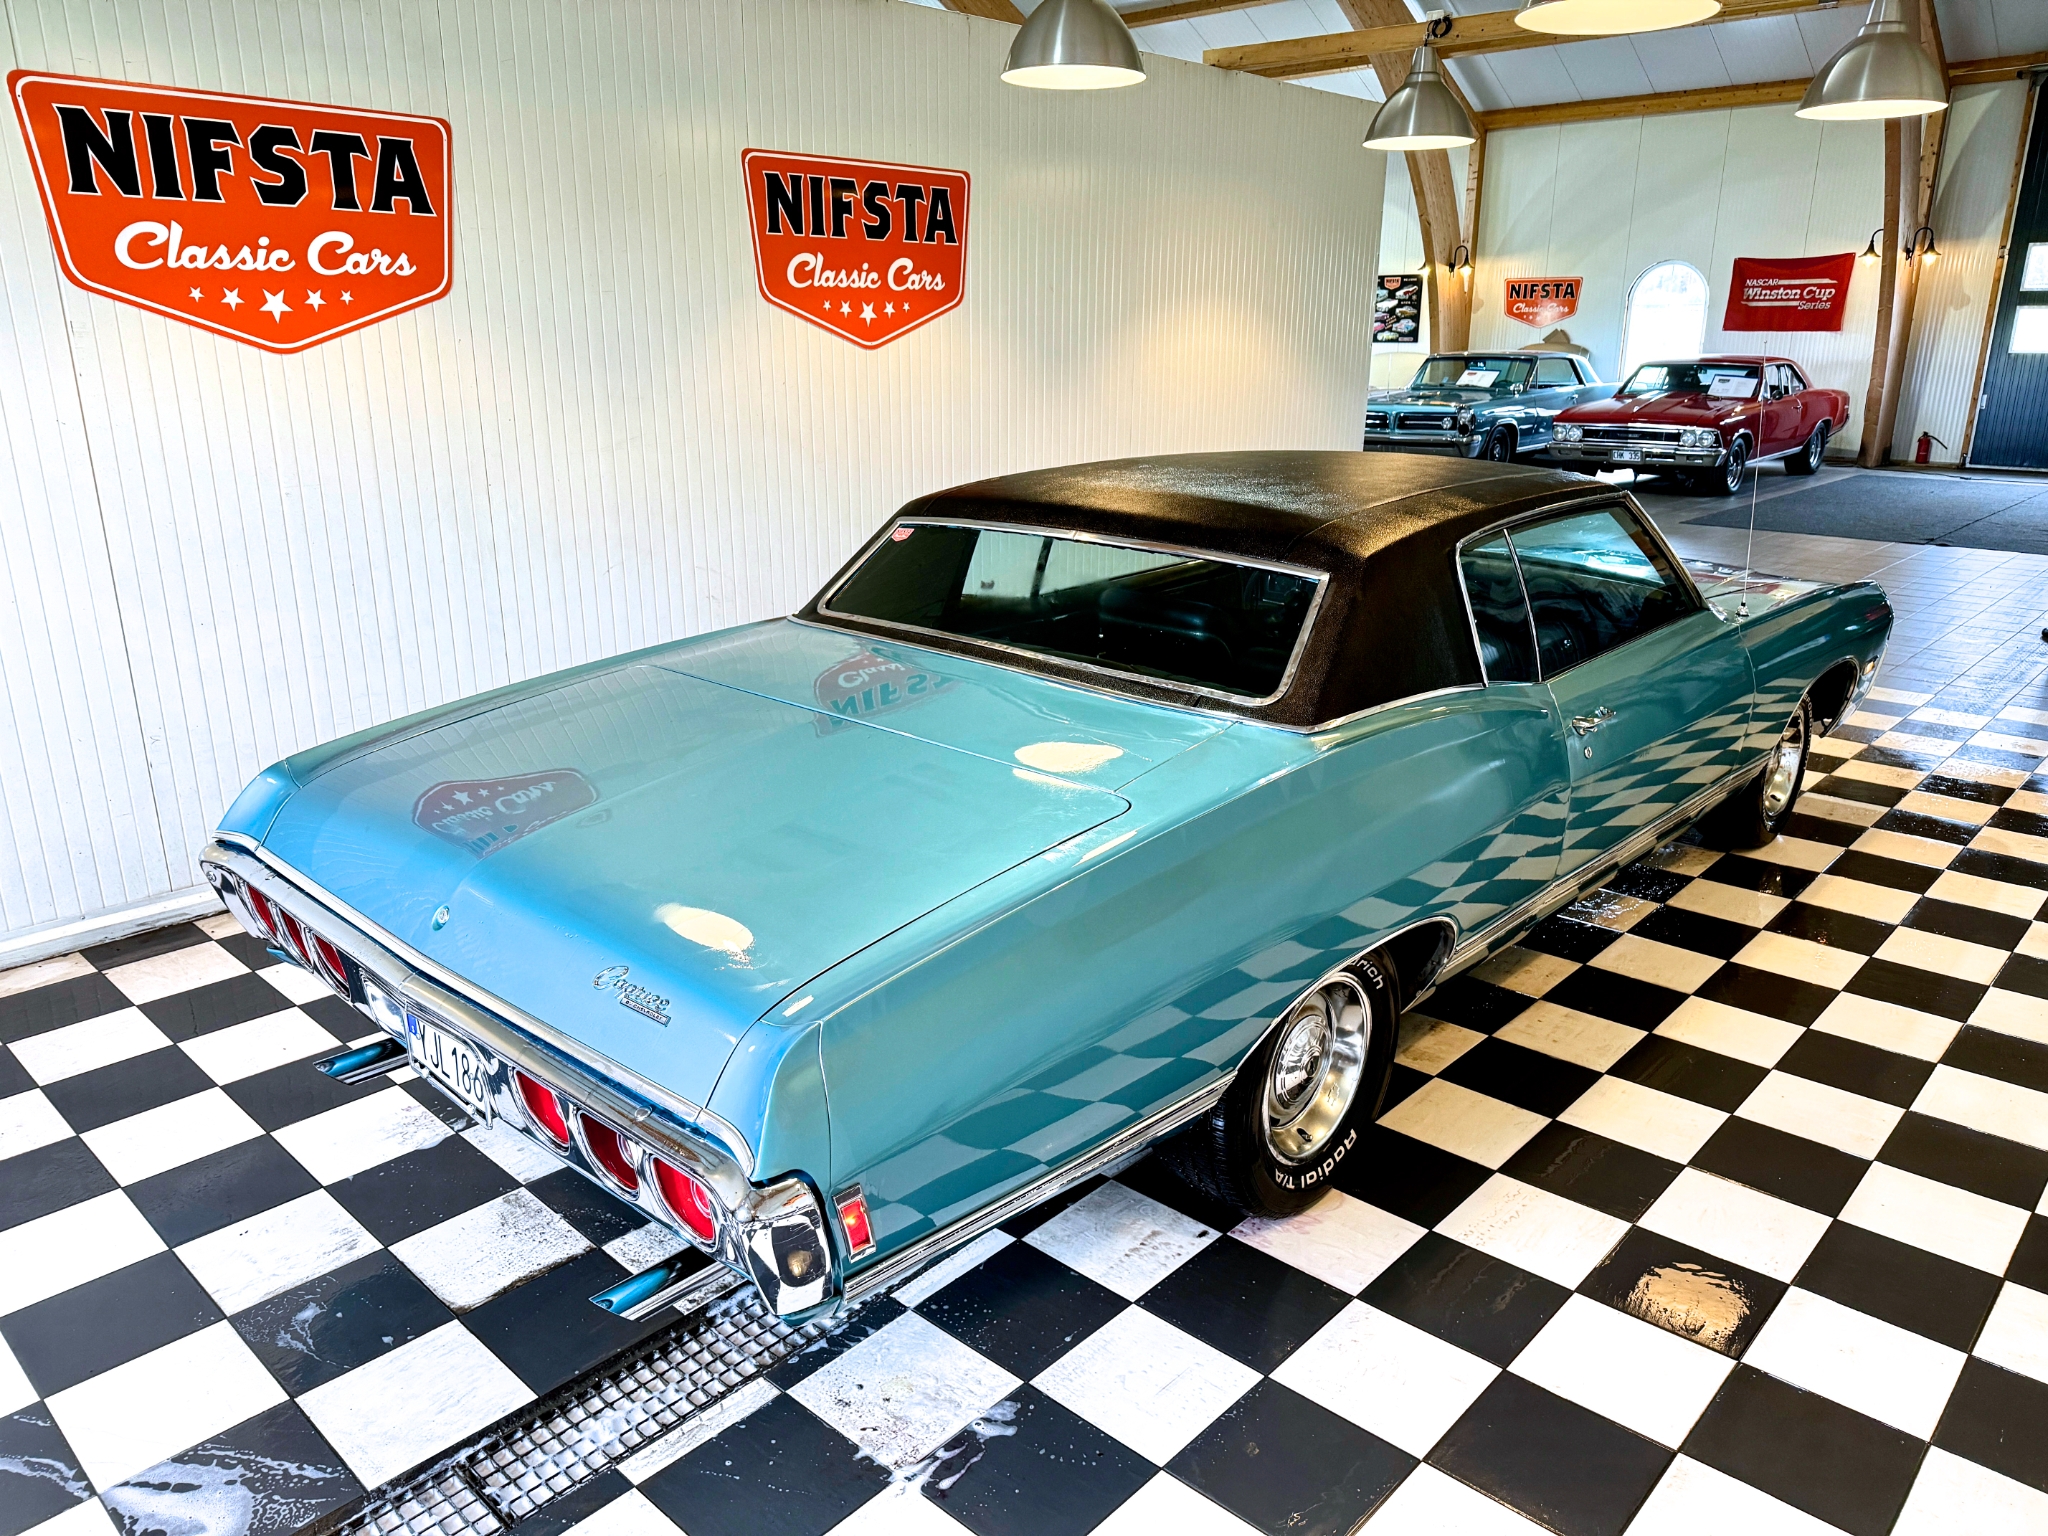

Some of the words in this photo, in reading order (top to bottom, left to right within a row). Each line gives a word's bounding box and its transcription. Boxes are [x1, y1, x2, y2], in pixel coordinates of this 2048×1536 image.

[51, 103, 437, 217] NIFSTA
[762, 170, 959, 246] NIFSTA
[114, 219, 295, 271] Classic
[307, 230, 417, 277] Cars
[786, 252, 881, 288] Classic
[887, 257, 945, 291] Cars
[1509, 282, 1576, 299] NIFSTA
[1745, 278, 1778, 286] NASCAR
[1513, 302, 1544, 313] Classic
[1547, 302, 1569, 313] Cars
[1743, 287, 1801, 300] Winston
[1803, 286, 1836, 301] Cup
[1798, 300, 1831, 310] Series
[592, 965, 670, 1012] Caprice
[417, 1019, 450, 1079] YJL
[452, 1047, 484, 1102] 186
[1300, 1128, 1358, 1189] Radial
[1275, 1168, 1295, 1190] T/A
